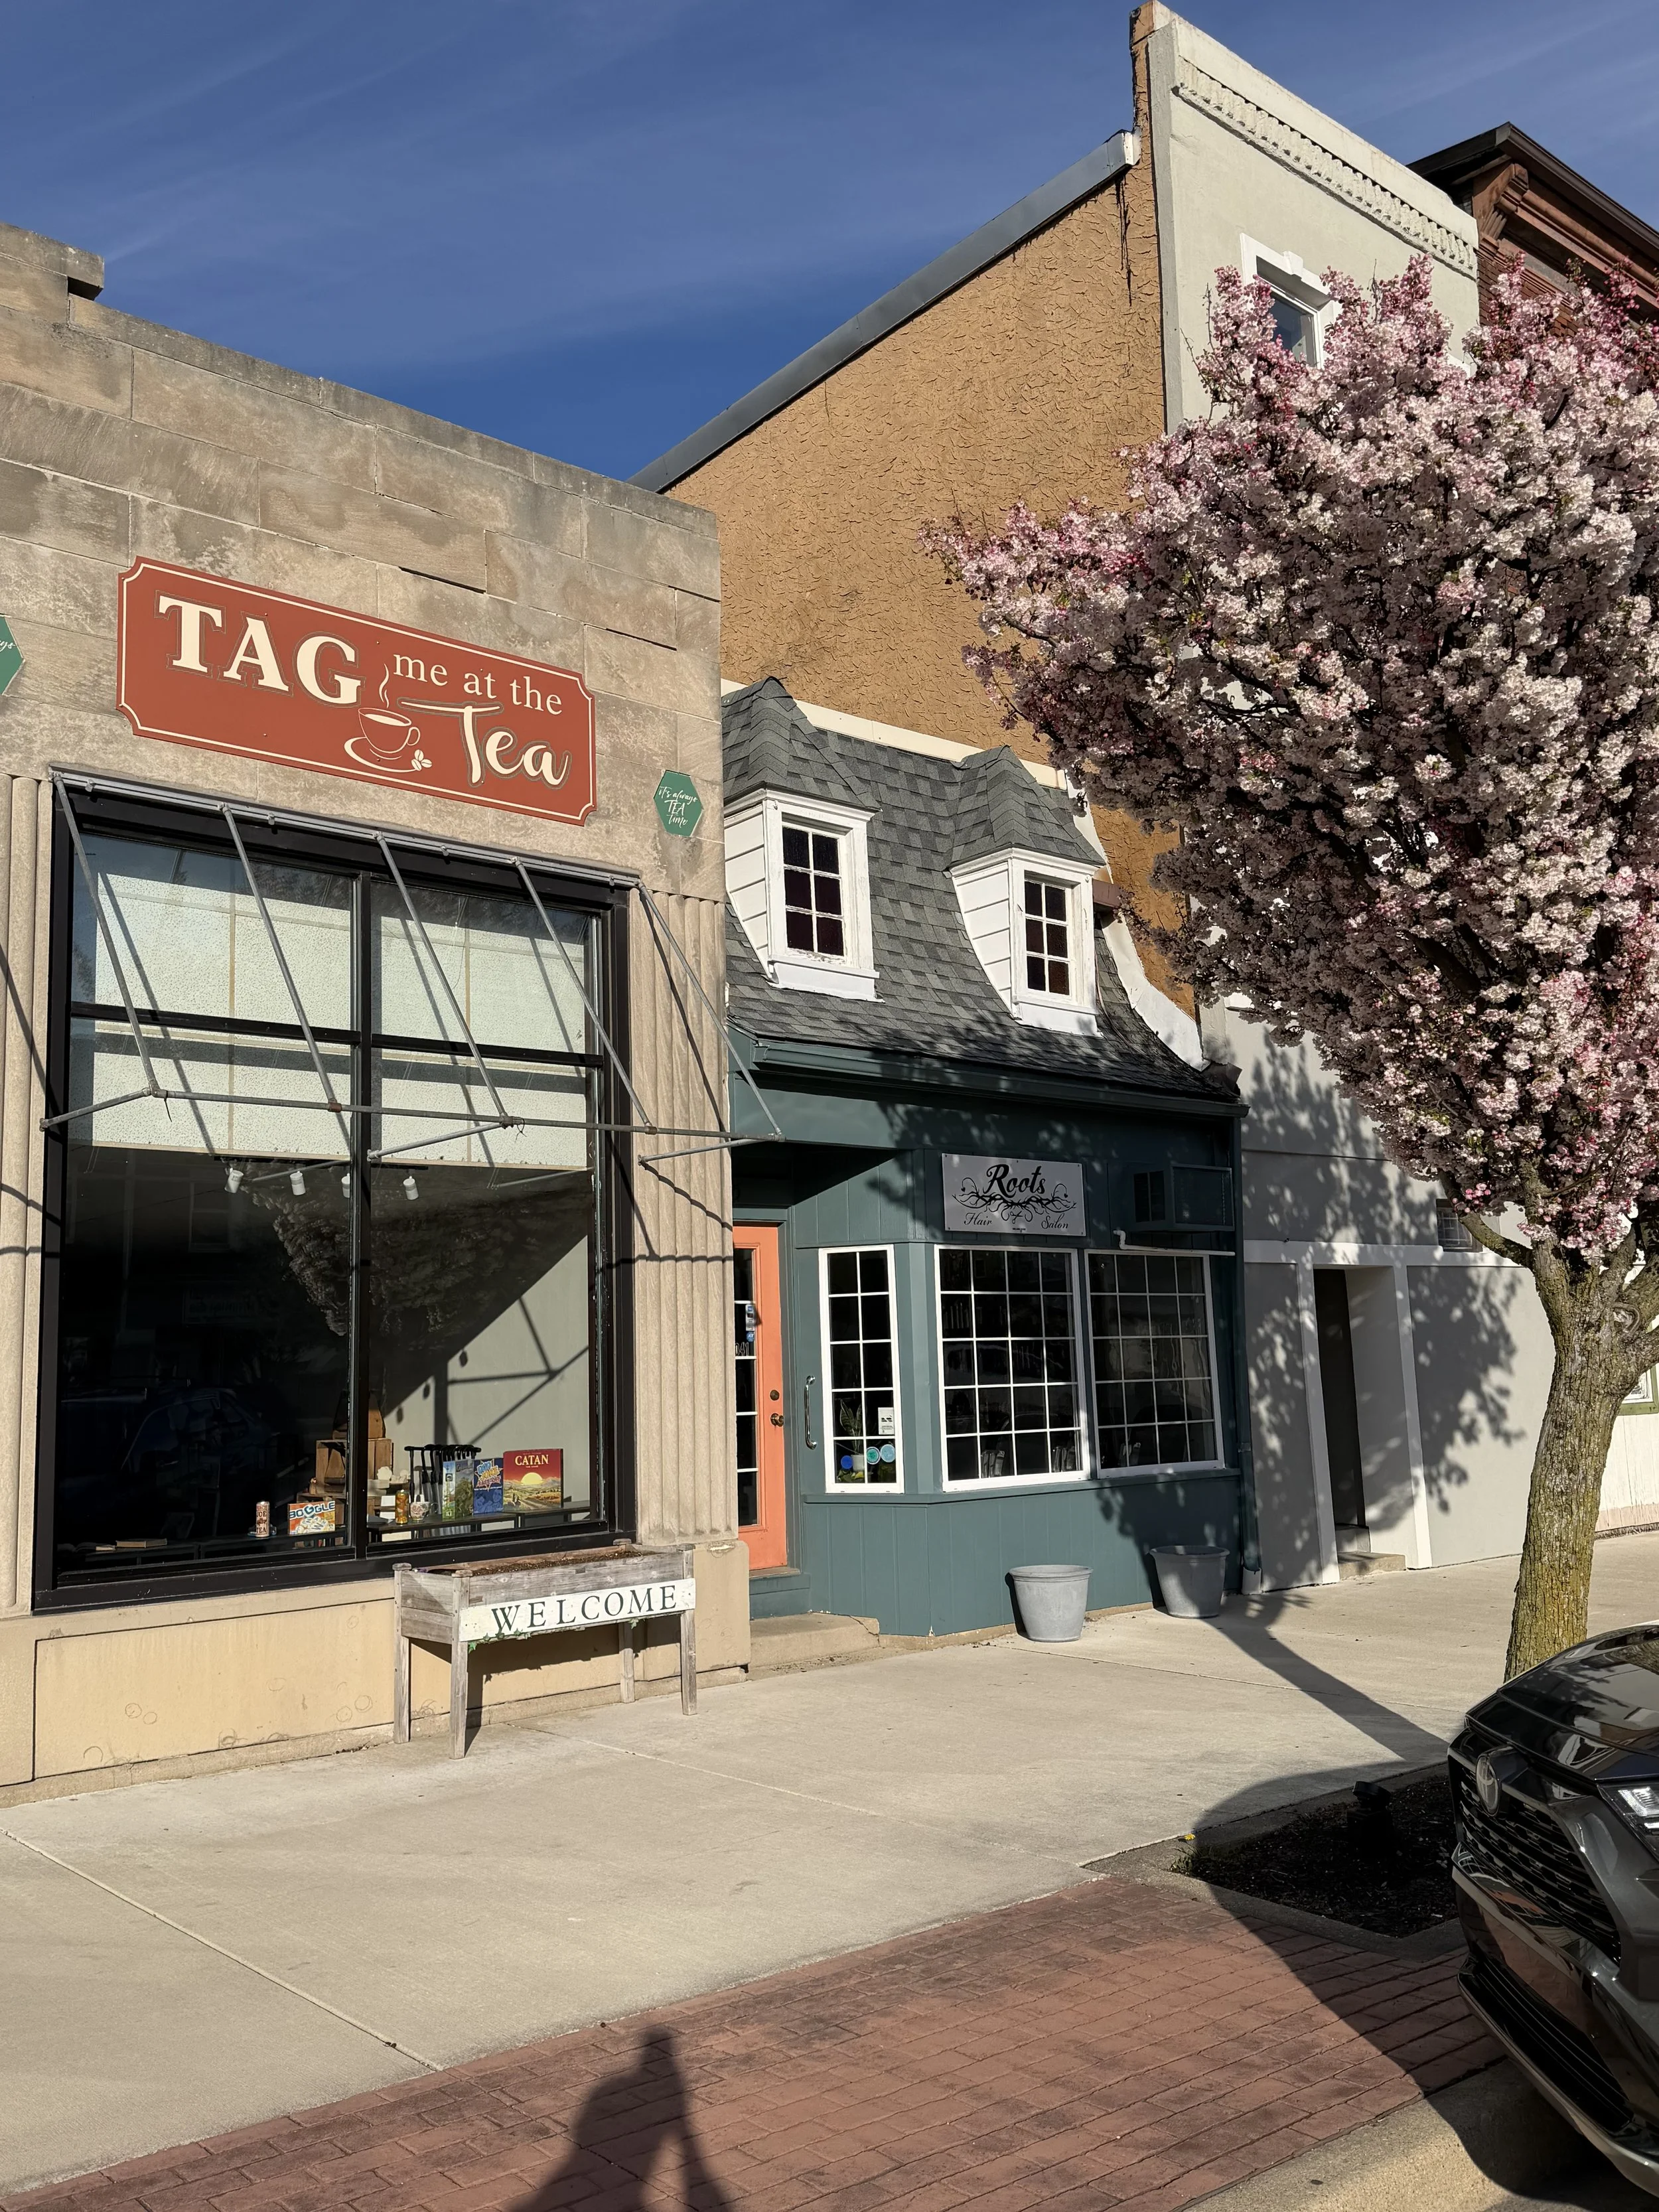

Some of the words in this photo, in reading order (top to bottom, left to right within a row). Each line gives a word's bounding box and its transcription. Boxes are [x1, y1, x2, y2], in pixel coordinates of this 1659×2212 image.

[159, 595, 361, 704] TAG
[394, 654, 447, 686] me
[464, 665, 497, 699] at
[510, 676, 562, 715] the
[400, 701, 569, 784] Tea
[664, 800, 685, 816] TEA
[673, 790, 697, 805] always
[983, 1163, 1046, 1199] Roots
[964, 1213, 993, 1226] Hair
[1041, 1213, 1068, 1230] Salon
[515, 1454, 549, 1466] CATAN
[289, 1502, 335, 1519] BOGGLE
[491, 1585, 676, 1632] WELCOME
